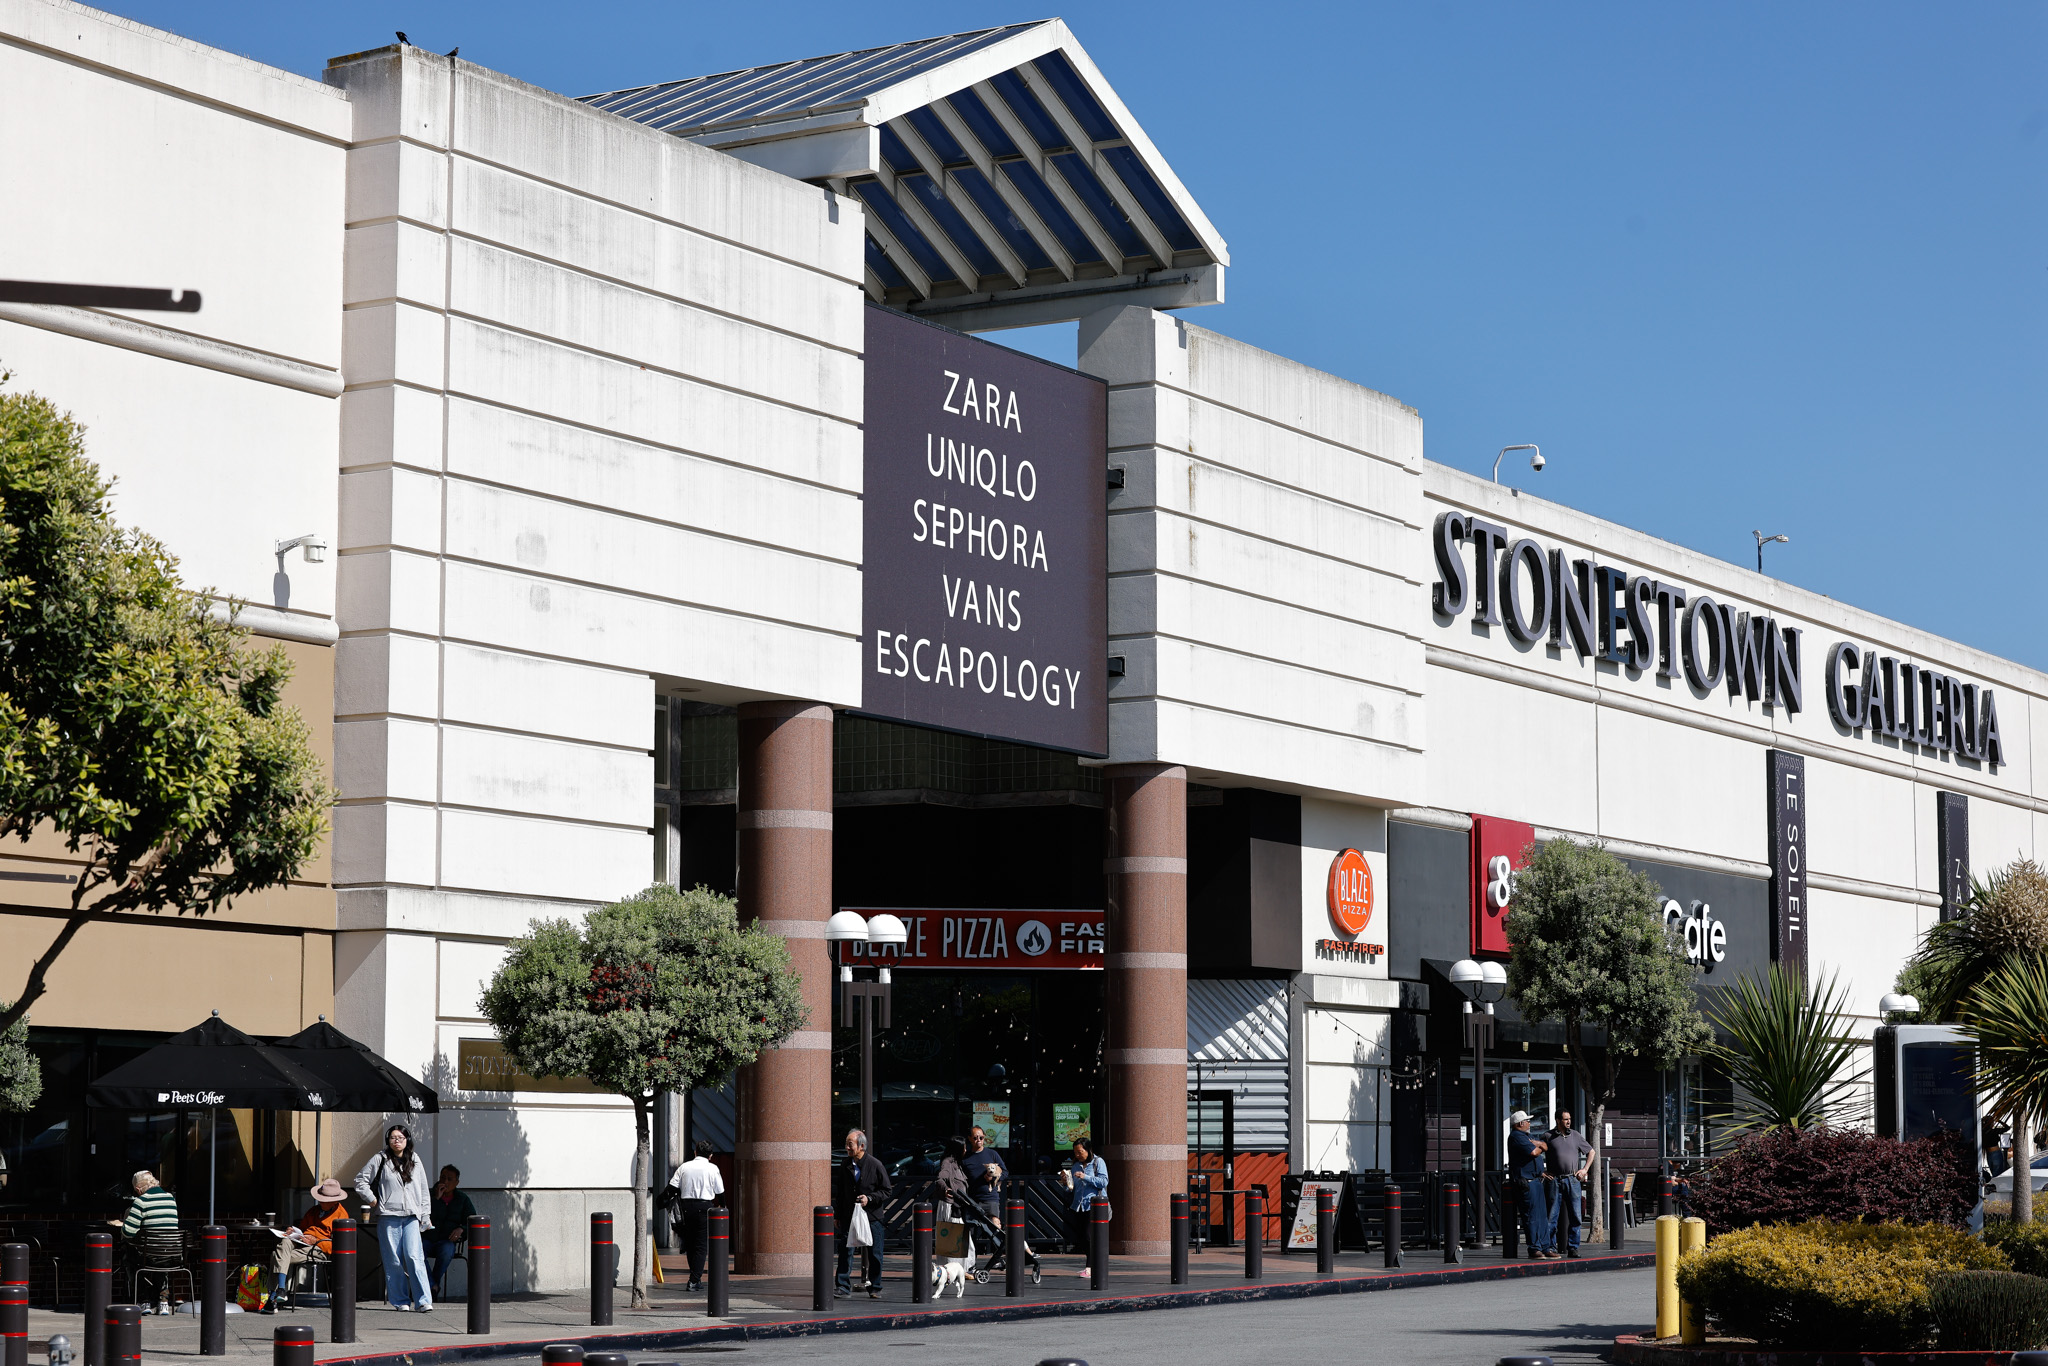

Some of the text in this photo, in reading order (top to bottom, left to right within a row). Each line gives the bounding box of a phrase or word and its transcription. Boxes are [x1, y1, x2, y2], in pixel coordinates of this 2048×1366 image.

[943, 369, 1022, 434] ZARA
[927, 432, 1037, 502] UNIQLO
[912, 498, 1049, 573] SEPHORA
[943, 573, 1022, 632] VANS
[1432, 510, 2007, 767] STONESTOWN GALLERIA
[876, 629, 1081, 710] ESCAPOLOGY
[1786, 773, 1800, 942] LE SOLEIL
[1340, 867, 1369, 904] BLAZE
[1342, 904, 1368, 916] PIZZA
[942, 917, 1009, 959] PIZZA
[1060, 922, 1105, 937] FAS
[1060, 939, 1105, 954] FIR
[465, 1055, 525, 1076] STONES
[195, 1090, 224, 1106] Coffee
